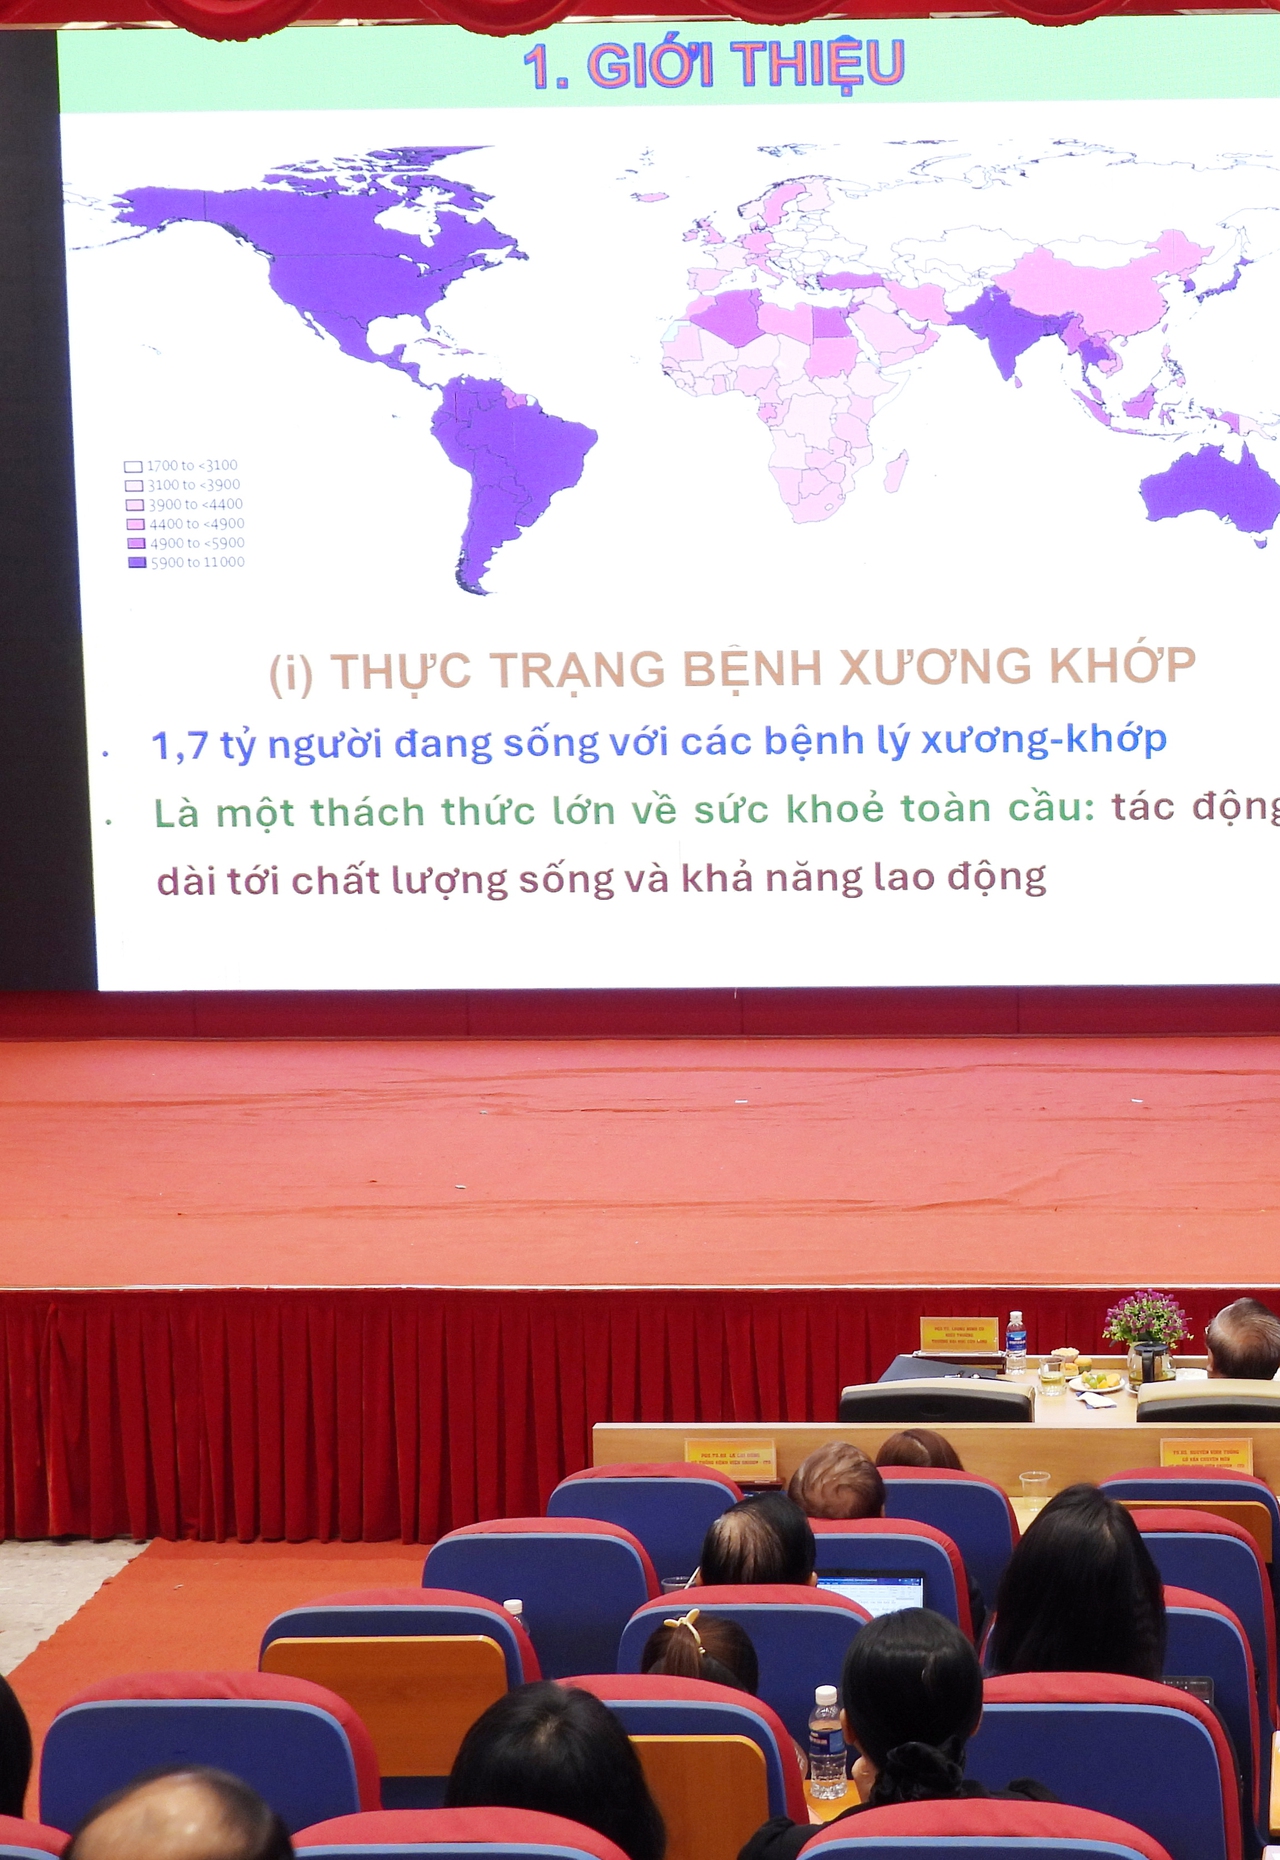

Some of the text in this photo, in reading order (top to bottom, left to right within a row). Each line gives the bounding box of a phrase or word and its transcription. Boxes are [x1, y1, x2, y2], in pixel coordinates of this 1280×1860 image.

[523, 30, 905, 97] 1. GIỚI THIỆU
[148, 459, 238, 472] 1700 to <3100
[148, 479, 240, 492] 3100 to <3900
[149, 498, 243, 512] 3900 to <4400
[150, 518, 245, 530] 4400 to <4900
[151, 537, 245, 550] 4900 to <5900
[151, 556, 245, 570] 5900 to 11000
[272, 638, 1196, 700] (i) THỰC TRẠNG BỆNH XƯƠNG KHỚP
[154, 722, 1168, 767] 1,7 tỷ người đang sống với các bệnh lý xương-khớp
[157, 798, 199, 828] Là
[219, 797, 295, 834] một
[311, 797, 424, 827] thách
[442, 796, 535, 826] thức
[555, 795, 615, 825] lớn
[633, 791, 677, 825] về
[696, 794, 769, 825] sức
[789, 791, 884, 824] khoẻ
[901, 792, 990, 823] toàn
[1010, 788, 1094, 822] cầu:
[1113, 791, 1175, 821] tác
[159, 860, 1047, 902] dài tới chất lượng sống và khả năng lao động
